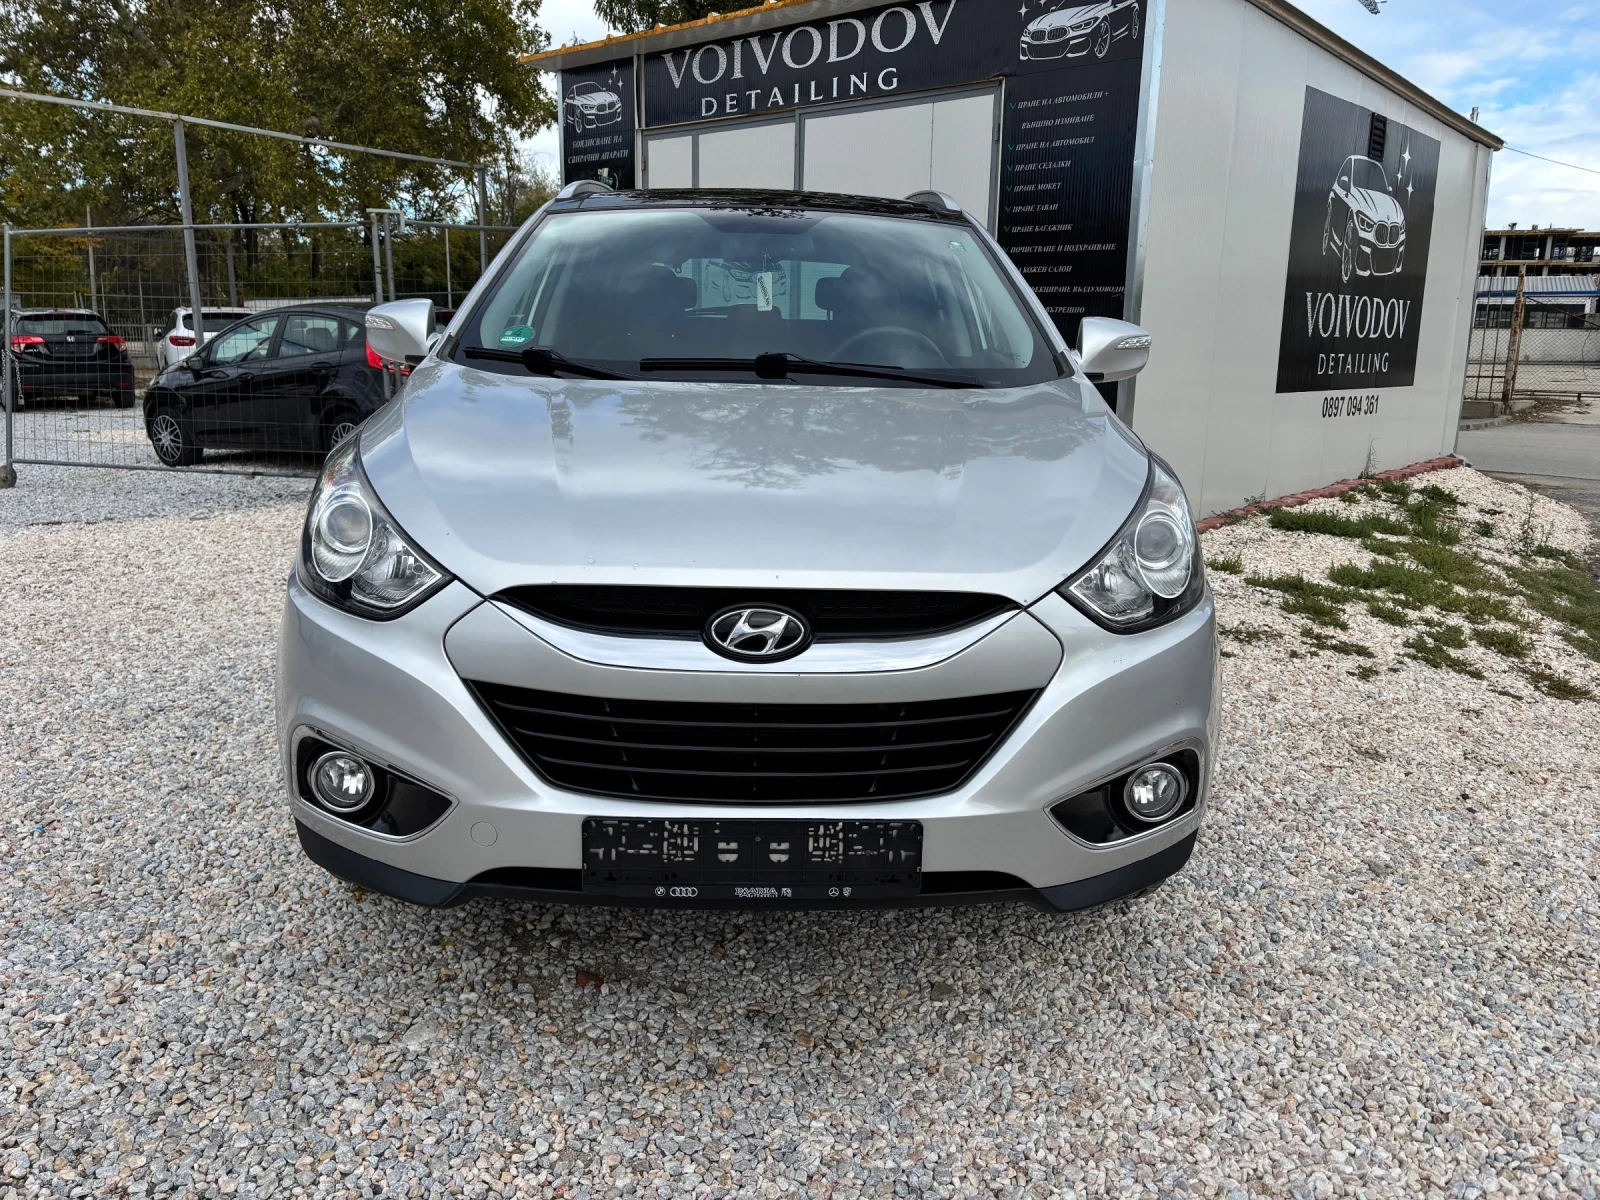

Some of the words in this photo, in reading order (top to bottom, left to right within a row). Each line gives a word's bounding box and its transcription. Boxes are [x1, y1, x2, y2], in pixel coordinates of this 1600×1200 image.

[661, 0, 957, 90] VOIVODOV
[701, 67, 899, 117] DETAILING
[1017, 99, 1041, 109] ПРАНЕ
[1041, 98, 1052, 106] НА
[1052, 91, 1103, 103] АВТОМОБИЛИ
[1021, 120, 1054, 129] ВЪНШНО
[1054, 115, 1094, 125] ИЗМИВАНЕ
[1039, 141, 1050, 149] НА
[1050, 136, 1095, 147] АВТОМОБИЛ
[1014, 164, 1037, 172] ПРАНЕ
[1038, 160, 1071, 169] СЕДАЛКИ
[1013, 184, 1036, 192] ПРАНЕ
[1037, 182, 1062, 190] МОКЕТ
[1012, 205, 1035, 213] ПРАНЕ
[1036, 203, 1058, 211] ТАВАН
[1011, 225, 1034, 233] ПРАНЕ
[1034, 223, 1073, 232] БАГАЖНИК
[1010, 245, 1056, 253] ПОЧИСТВАНЕ
[1022, 266, 1047, 274] КОЖЕН
[1047, 265, 1072, 273] САЛОН
[1305, 291, 1411, 339] VOIVODOV
[1317, 352, 1389, 375] DETAILING
[1321, 396, 1345, 418] 0897
[1346, 395, 1362, 416] 094
[1363, 394, 1379, 415] 361
